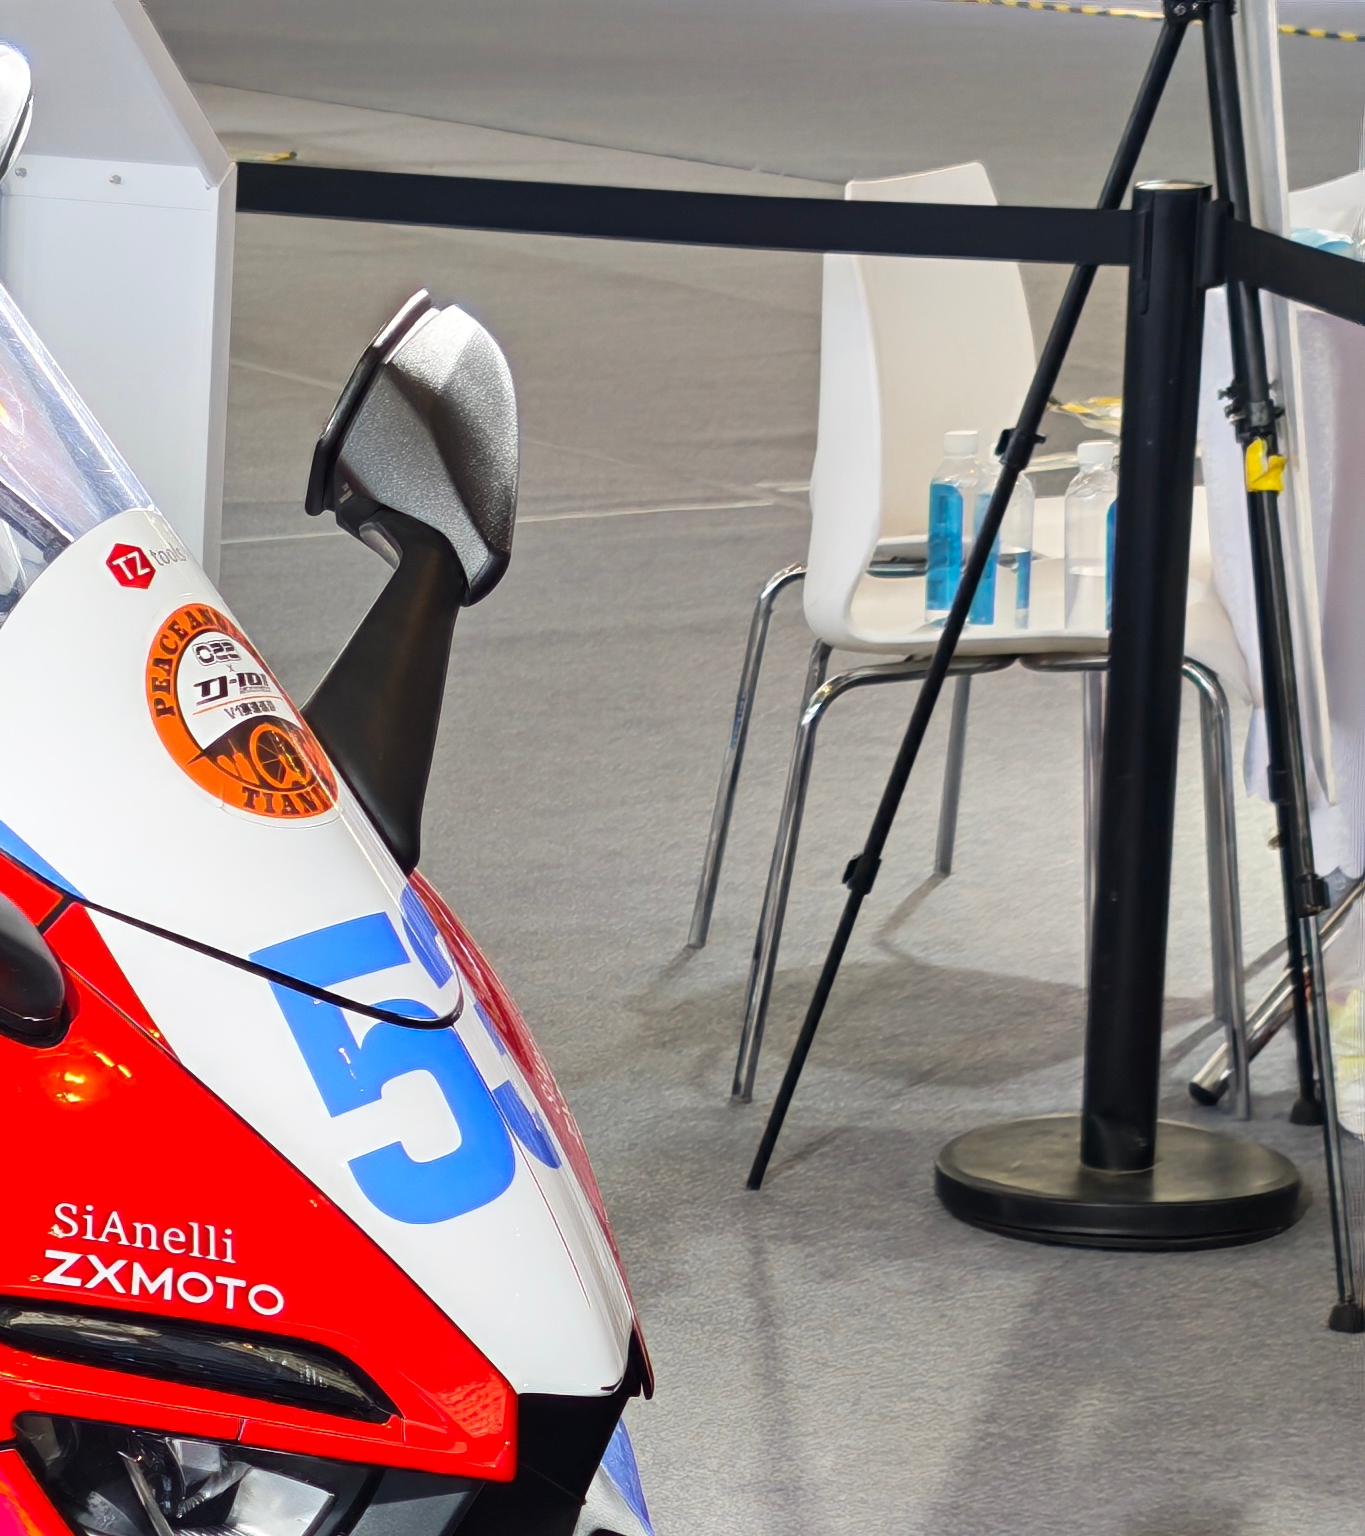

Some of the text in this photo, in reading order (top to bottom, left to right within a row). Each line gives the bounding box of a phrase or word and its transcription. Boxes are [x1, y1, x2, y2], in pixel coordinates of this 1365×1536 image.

[111, 551, 151, 581] TZ
[54, 1202, 237, 1264] SiAnelli
[42, 1249, 285, 1317] ZXMOTO
